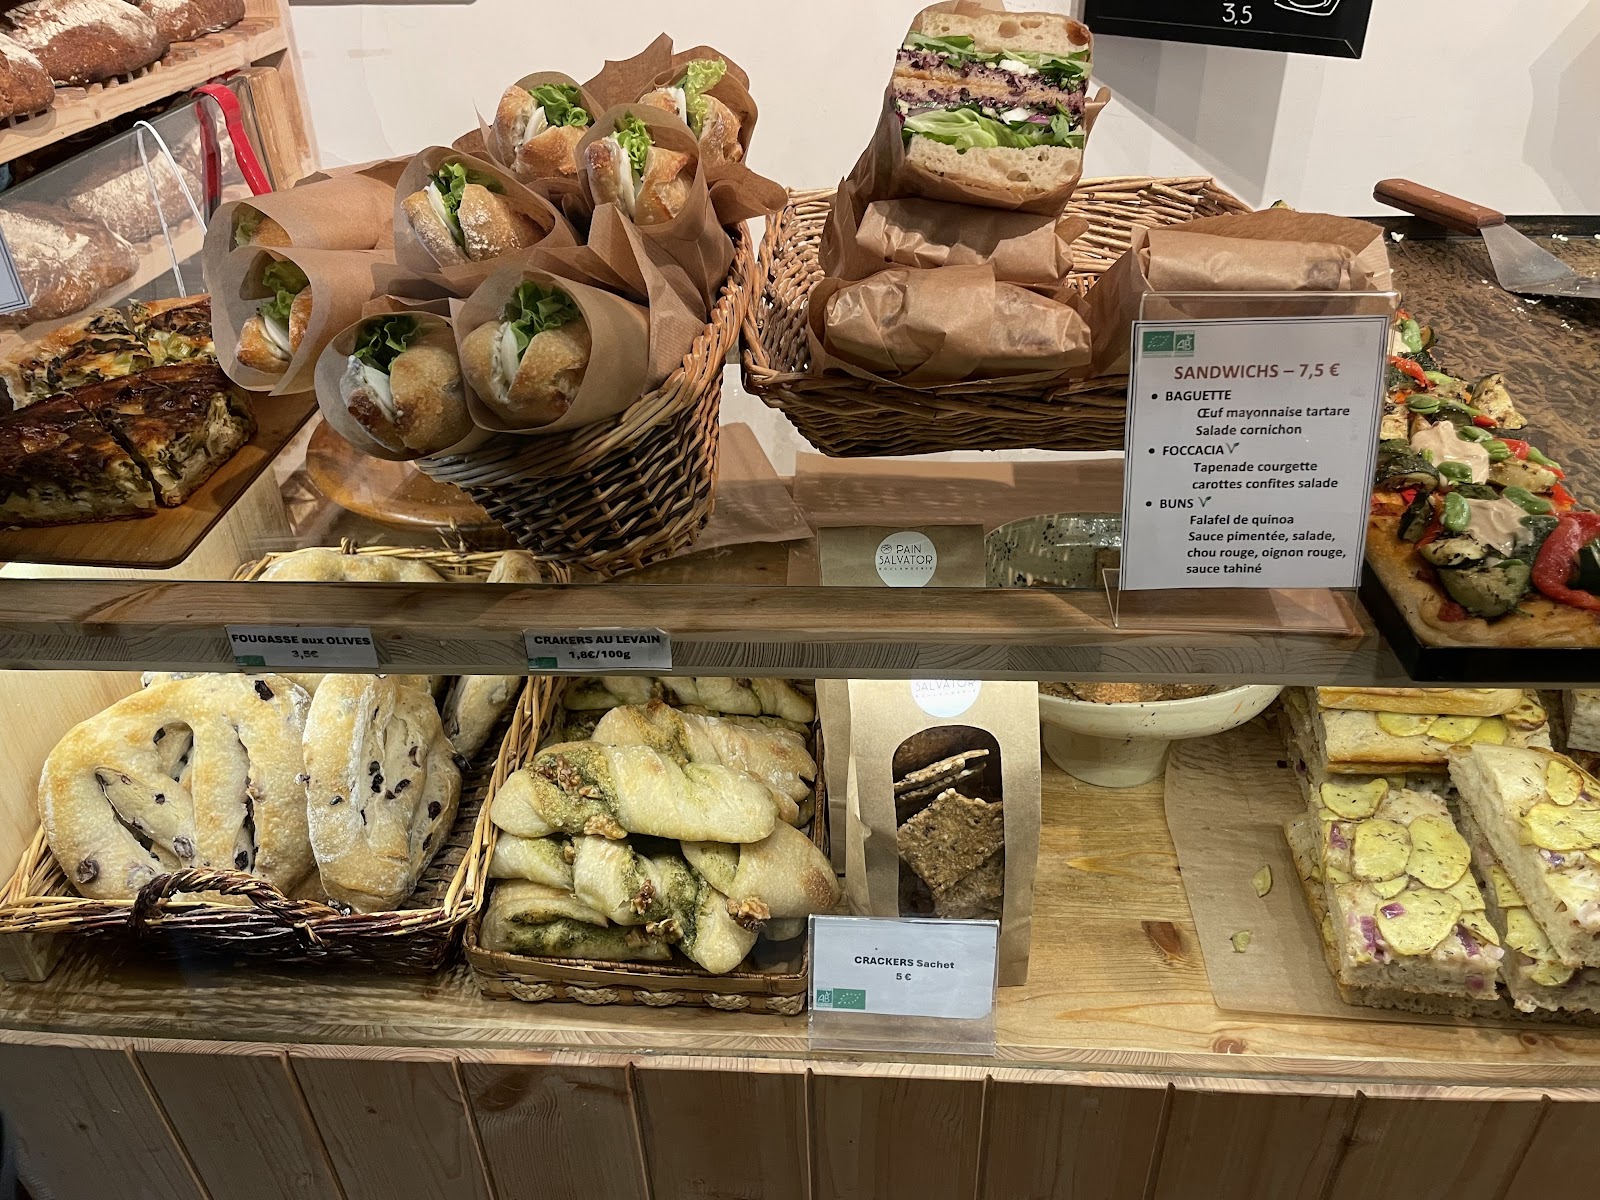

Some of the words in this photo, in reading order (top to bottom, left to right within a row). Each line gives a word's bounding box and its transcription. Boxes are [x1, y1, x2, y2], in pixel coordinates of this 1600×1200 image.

[1222, 2, 1253, 26] 3,5
[1174, 365, 1279, 380] SANDWICHS
[1299, 364, 1324, 379] 7,5
[1329, 362, 1340, 377] €
[1165, 390, 1232, 401] BAGUETTE
[1197, 406, 1224, 418] Œuf
[1226, 407, 1304, 420] mayonnaise
[1306, 406, 1350, 417] tartare
[1196, 424, 1236, 436] Salade
[1240, 424, 1302, 435] cornichon
[1162, 445, 1224, 456] FOCCACIA
[1194, 462, 1254, 475] Tapenade
[1258, 461, 1318, 474] courgette
[1192, 478, 1242, 489] carottes
[1245, 478, 1295, 489] confites
[1298, 478, 1338, 489] salade
[1160, 498, 1194, 509] BUNS
[1190, 514, 1230, 525] Falafel
[1233, 514, 1248, 525] de
[1251, 515, 1294, 528] quinoa
[1188, 531, 1224, 542] Sauce
[1227, 530, 1289, 544] pimentée,
[1292, 530, 1336, 543] salade,
[896, 544, 922, 554] PAIN
[1187, 547, 1216, 558] chou
[1219, 549, 1258, 561] rouge,
[1262, 547, 1304, 560] oignon
[1307, 548, 1346, 560] rouge,
[878, 555, 933, 565] SALVATOR
[1186, 565, 1220, 574] sauce
[1223, 563, 1262, 574] tahiné
[231, 634, 299, 644] FOUGASSE
[326, 636, 371, 645] OLIVES
[534, 636, 593, 645] CRAKERS
[596, 635, 613, 644] AU
[616, 635, 660, 644] LEVAIN
[291, 650, 320, 660] 3,5€
[568, 650, 632, 660] 1,8€/100g
[854, 956, 914, 967] CRACKERS
[916, 959, 955, 969] Sachet
[896, 973, 902, 981] 5
[904, 973, 912, 981] €
